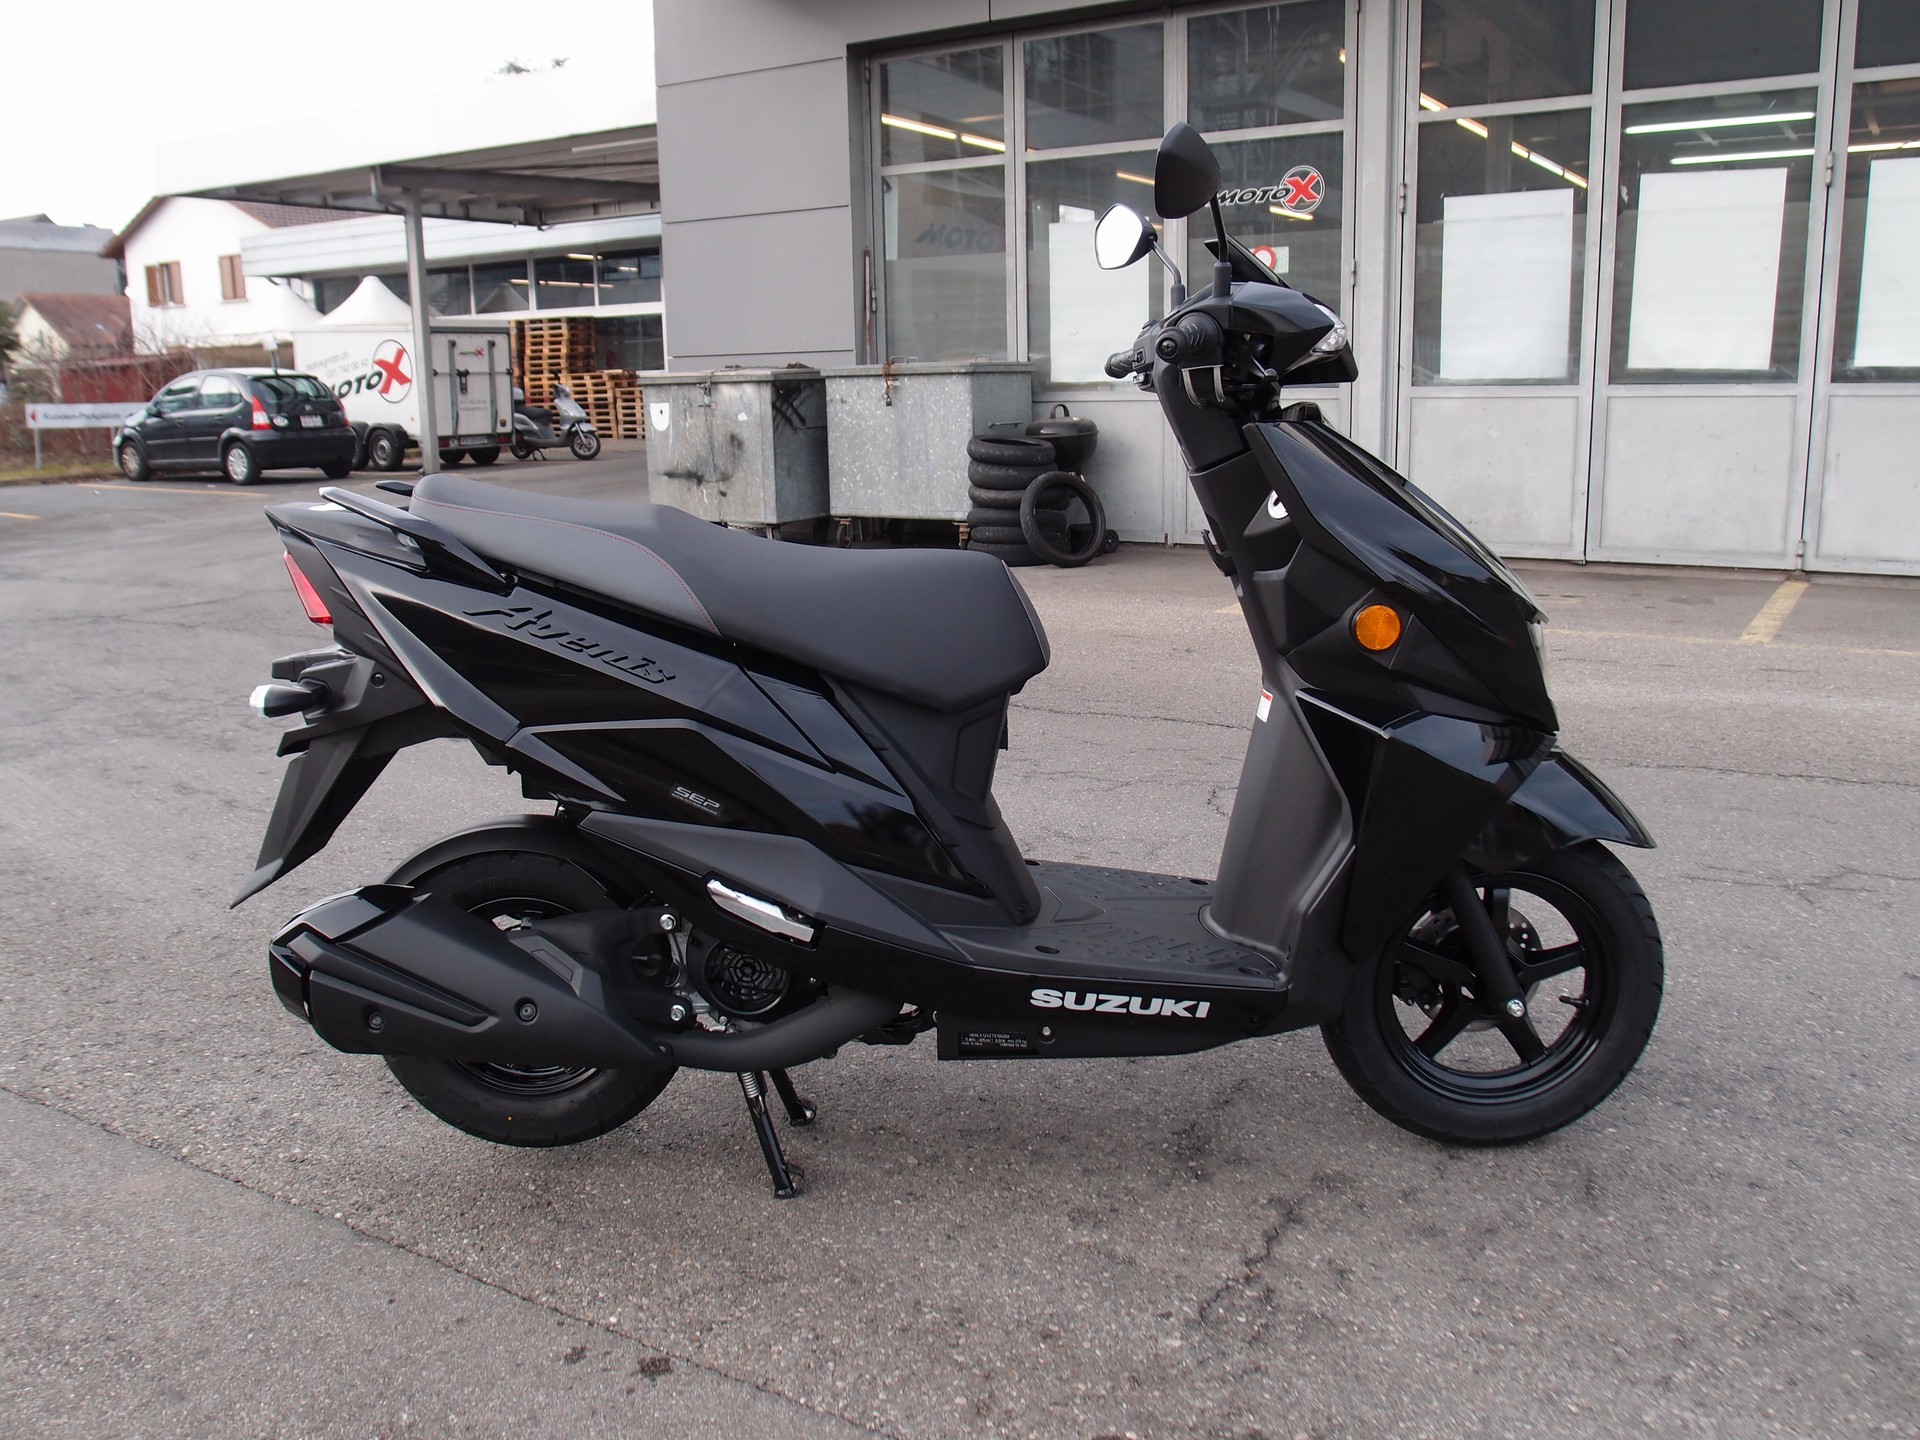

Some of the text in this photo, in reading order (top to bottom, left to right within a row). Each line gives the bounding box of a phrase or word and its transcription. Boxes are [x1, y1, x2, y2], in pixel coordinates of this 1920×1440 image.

[331, 347, 412, 399] OTOX
[463, 607, 676, 683] Avenis
[673, 786, 720, 808] SEP
[1030, 988, 1210, 1018] SUZUKI
